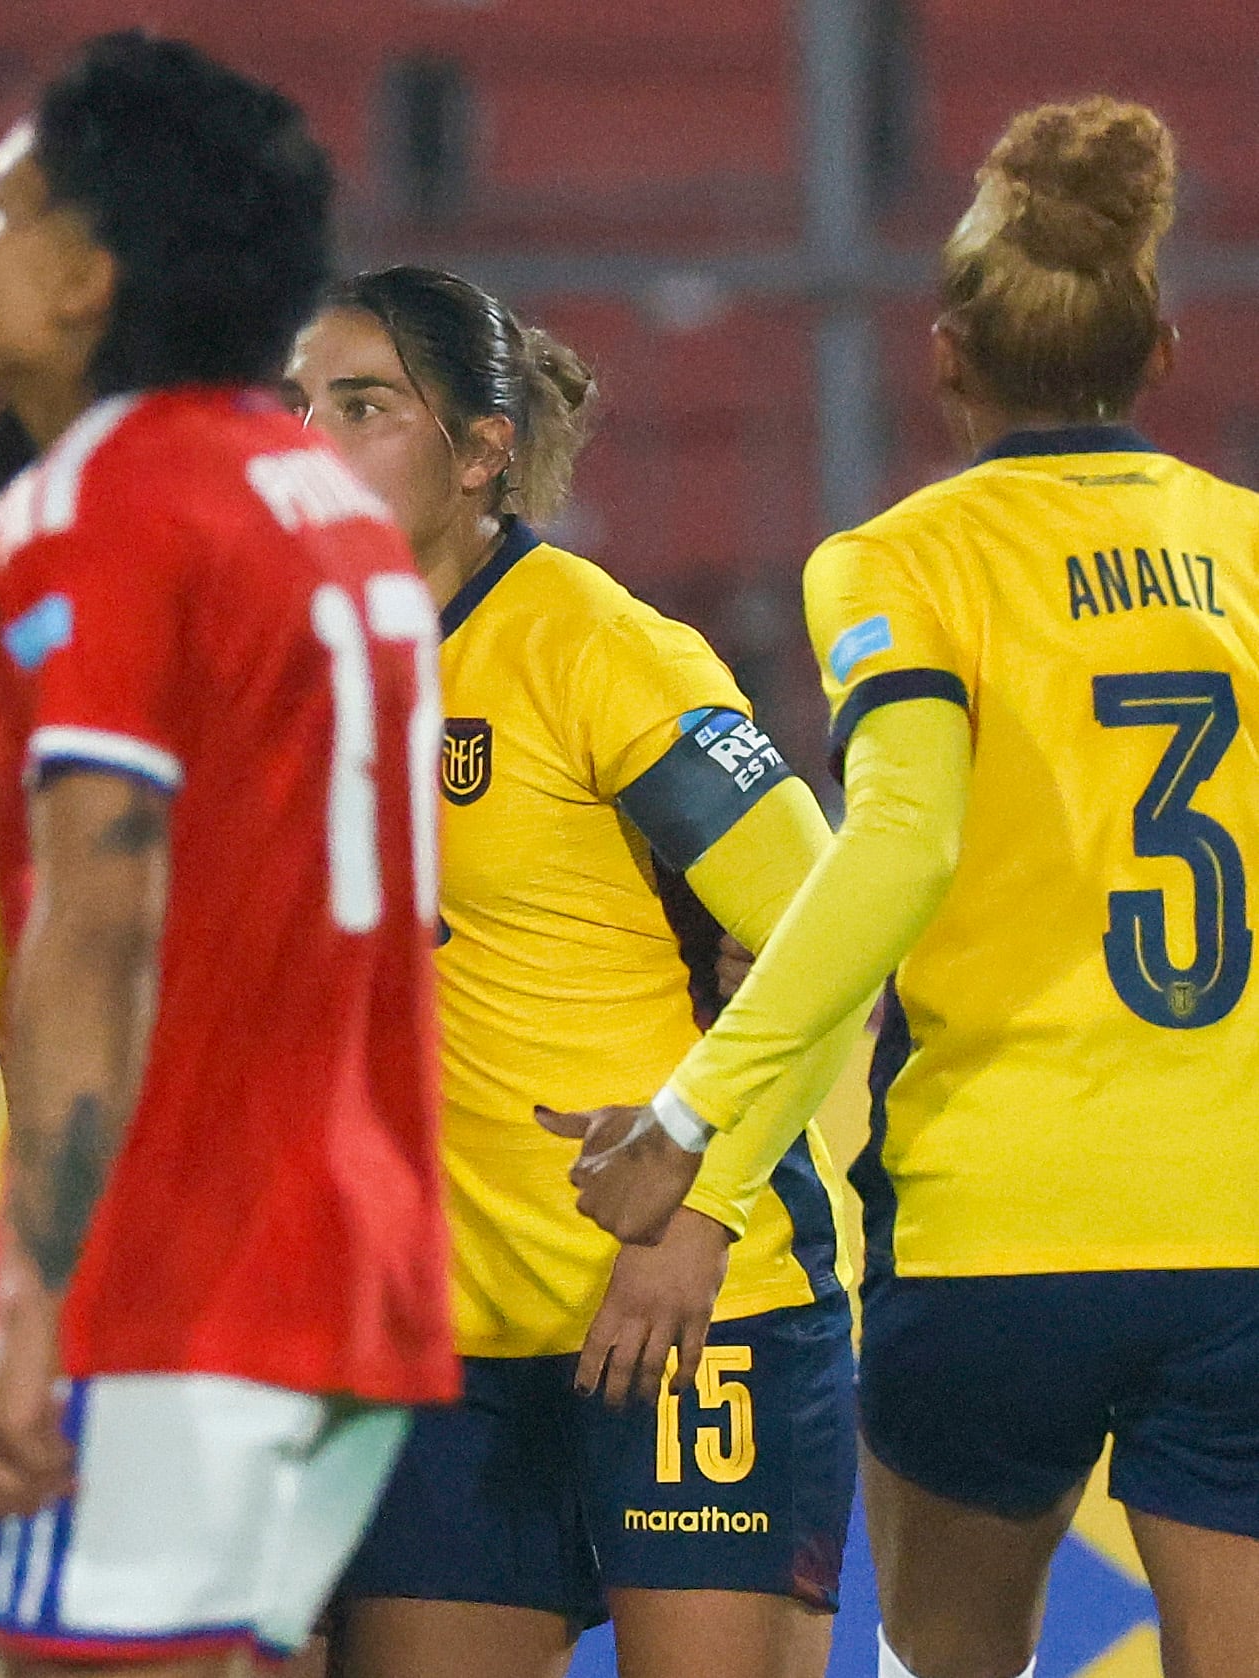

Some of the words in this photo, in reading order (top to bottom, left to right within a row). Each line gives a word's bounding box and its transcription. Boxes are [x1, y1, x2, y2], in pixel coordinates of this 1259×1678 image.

[1065, 547, 1225, 620] ANALIZ
[694, 725, 721, 749] EL
[706, 719, 772, 773] RE
[1092, 671, 1253, 1030] 3
[656, 1345, 756, 1483] 15
[625, 1505, 769, 1533] marathon
